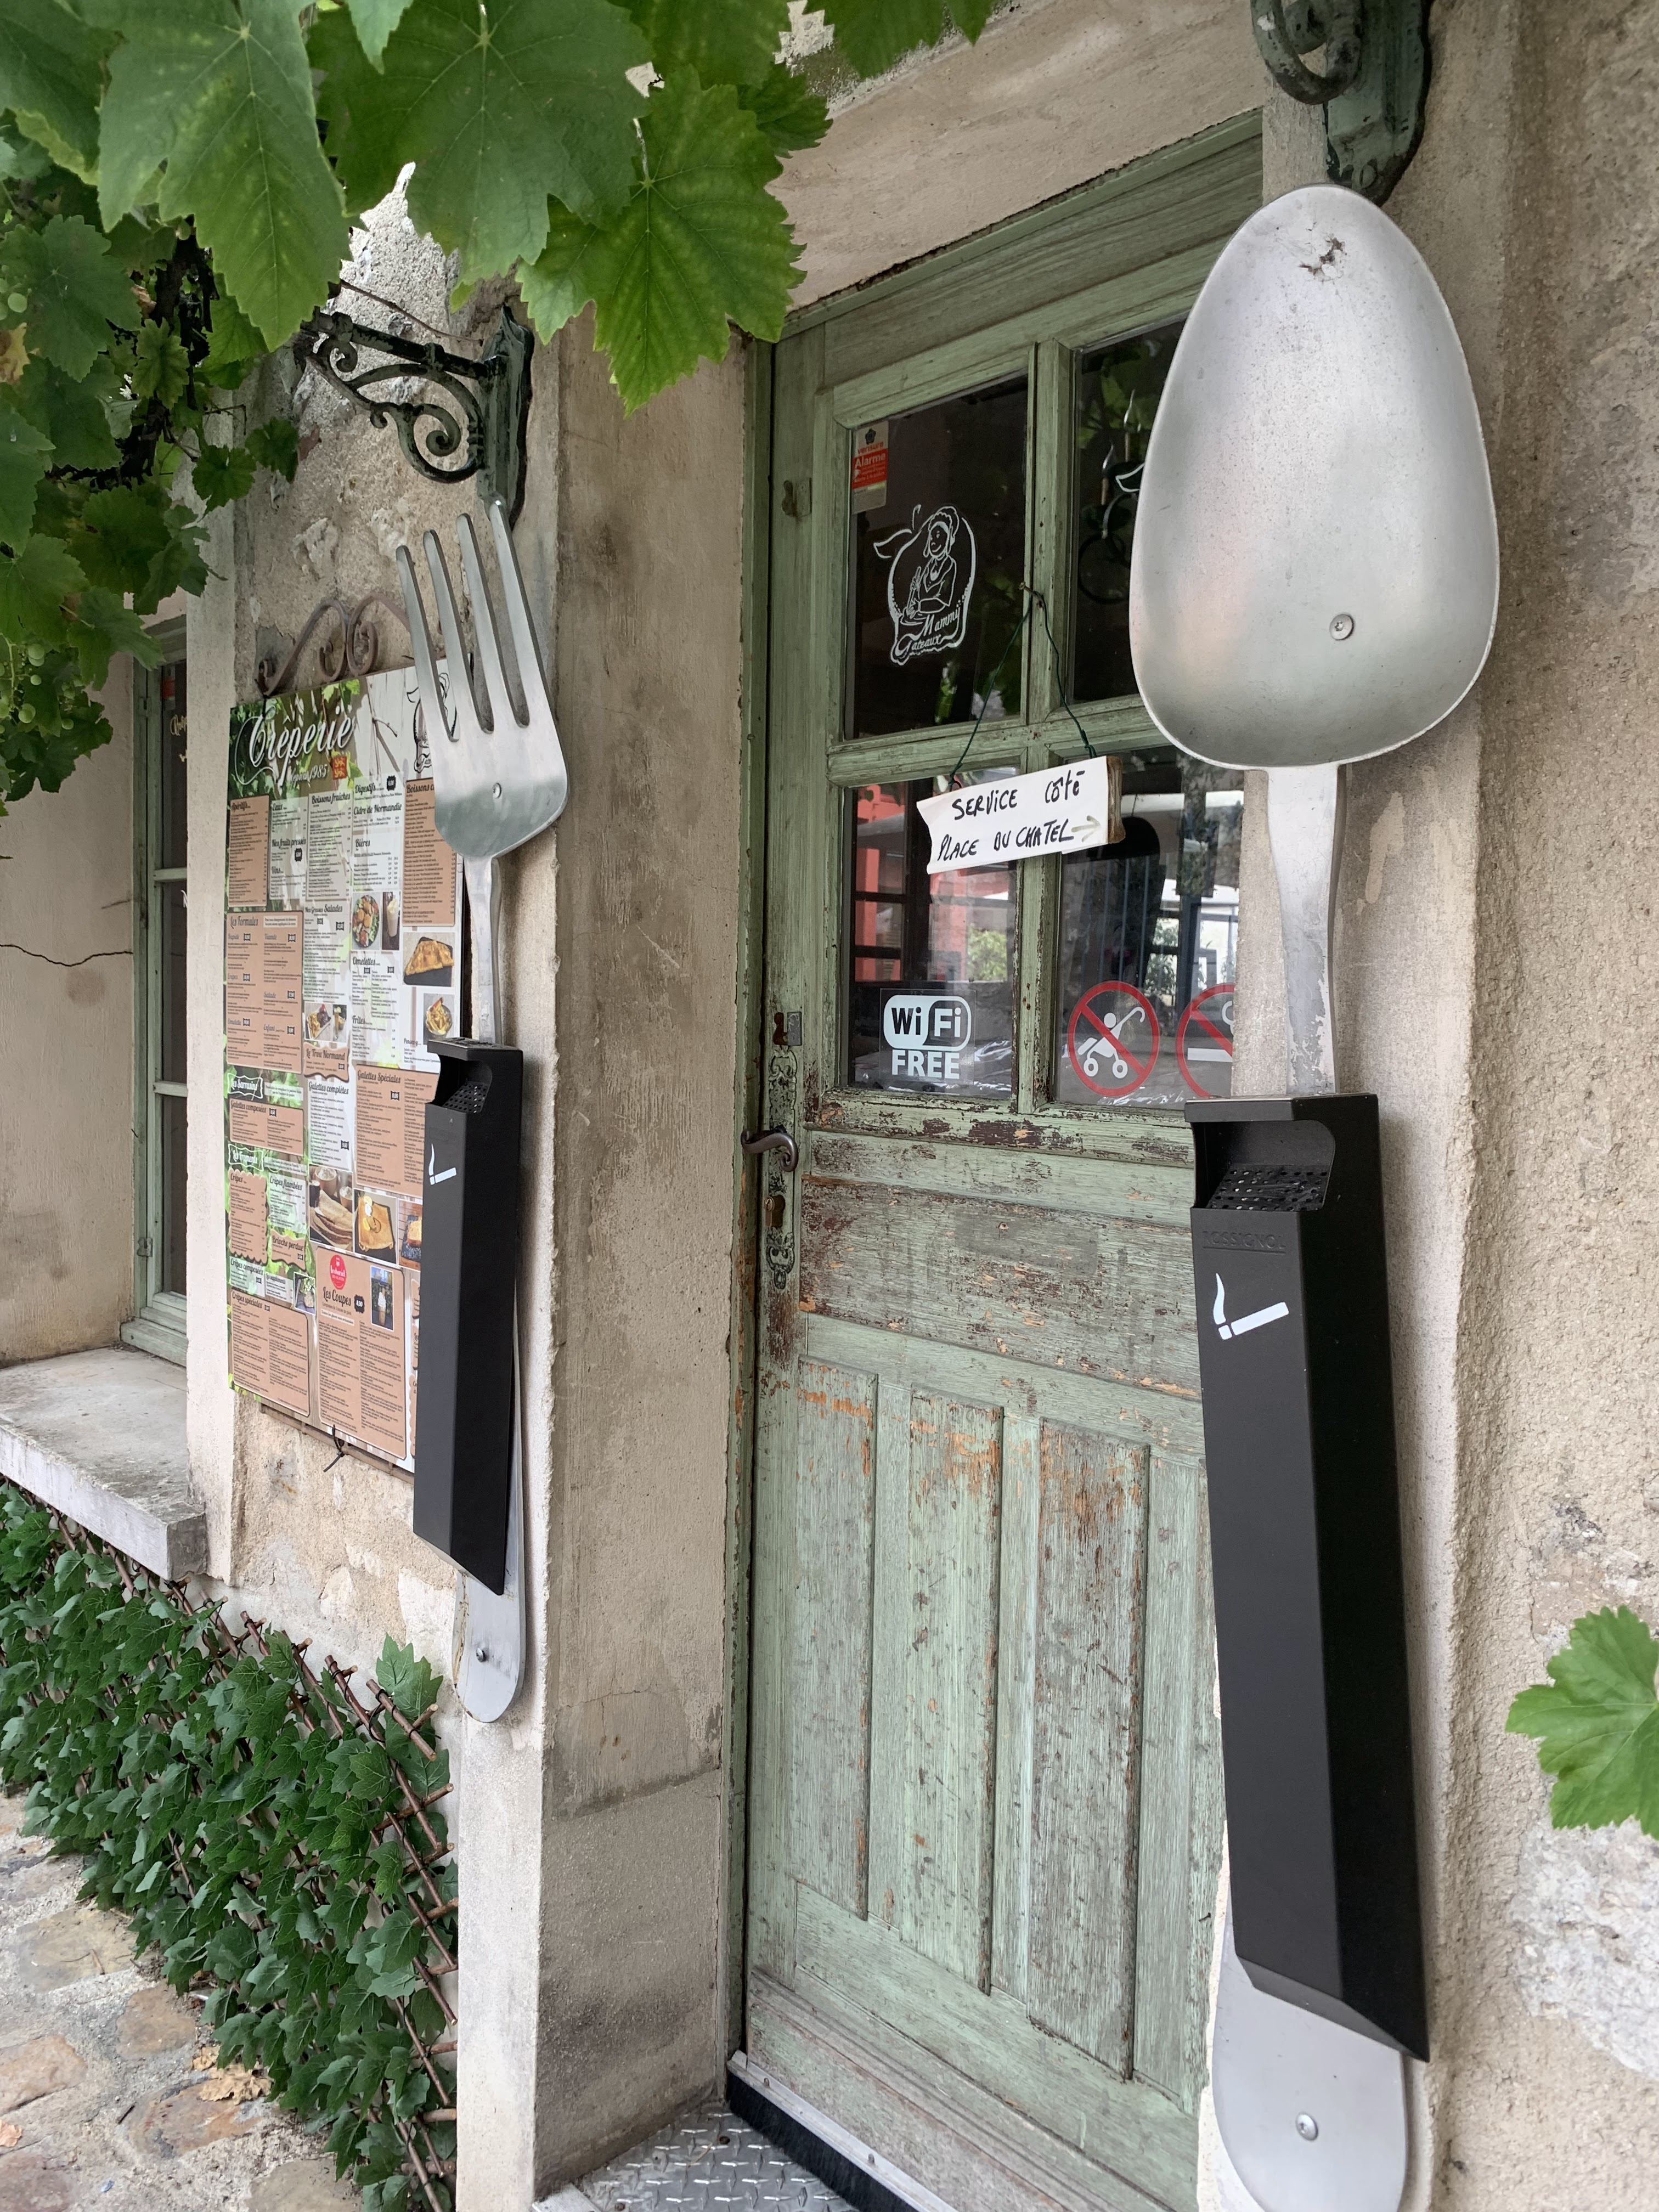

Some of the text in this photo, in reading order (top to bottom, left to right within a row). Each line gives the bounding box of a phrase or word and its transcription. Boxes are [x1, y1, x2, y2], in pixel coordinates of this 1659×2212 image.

[855, 452, 886, 468] Alarme
[922, 607, 960, 636] Mammy
[895, 634, 942, 657] Gateaux
[235, 706, 356, 788] Crêperie
[309, 764, 328, 780] 1985
[407, 783, 430, 793] Boissons
[312, 795, 331, 804] Boissons
[951, 788, 1018, 820] SERVICE
[354, 806, 366, 815] Cidre
[374, 803, 402, 813] Normandie
[937, 817, 1075, 861] PLACE DU CHATEL
[324, 904, 343, 912] Salades
[352, 956, 376, 966] Omelettes
[352, 1015, 365, 1025] Frites
[891, 1048, 960, 1080] FREE
[358, 1070, 401, 1084] Galettes Spéciales
[309, 1081, 326, 1091] Galettes
[270, 1176, 283, 1188] Crêpes
[232, 1291, 245, 1302] Crêpes
[332, 1289, 351, 1307] Coupes
